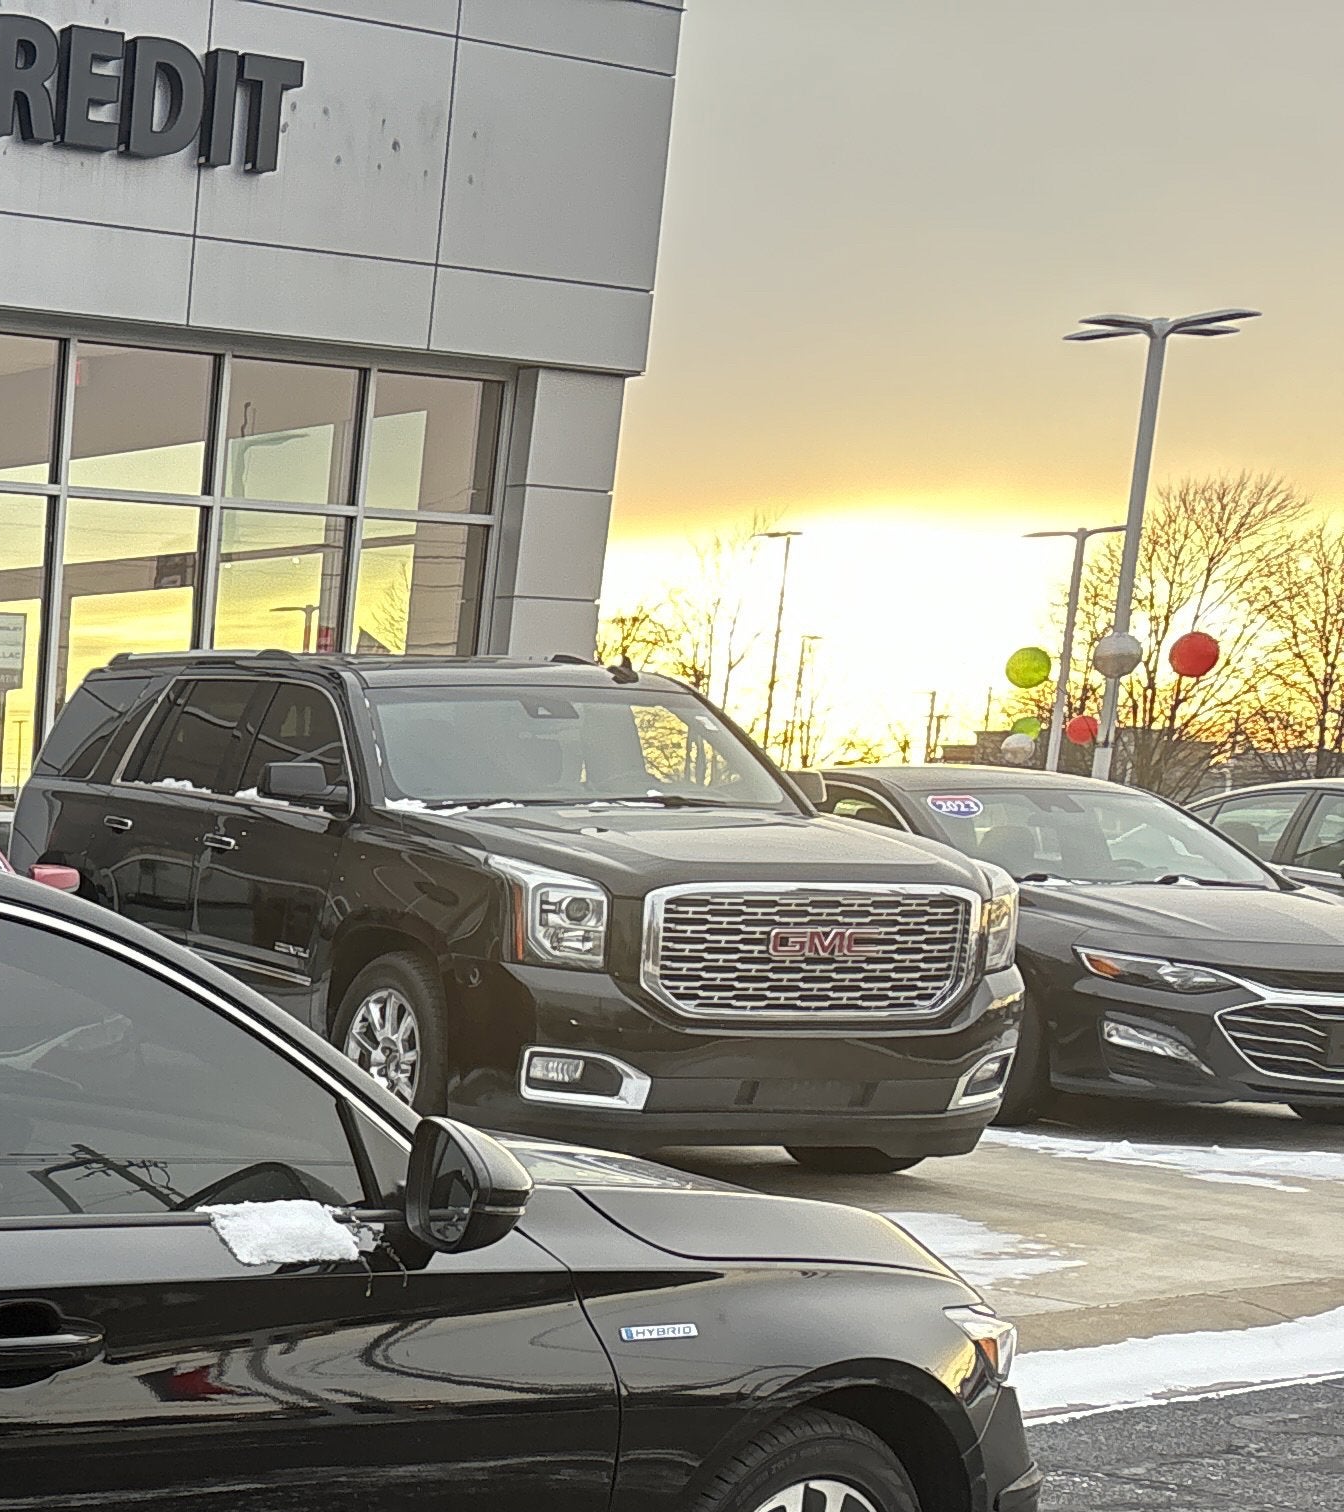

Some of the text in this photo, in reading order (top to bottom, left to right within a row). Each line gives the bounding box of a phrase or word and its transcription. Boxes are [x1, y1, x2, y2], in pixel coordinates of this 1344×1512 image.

[935, 800, 979, 812] 2023
[770, 928, 880, 956] GMC
[636, 1326, 692, 1337] HYBRID
